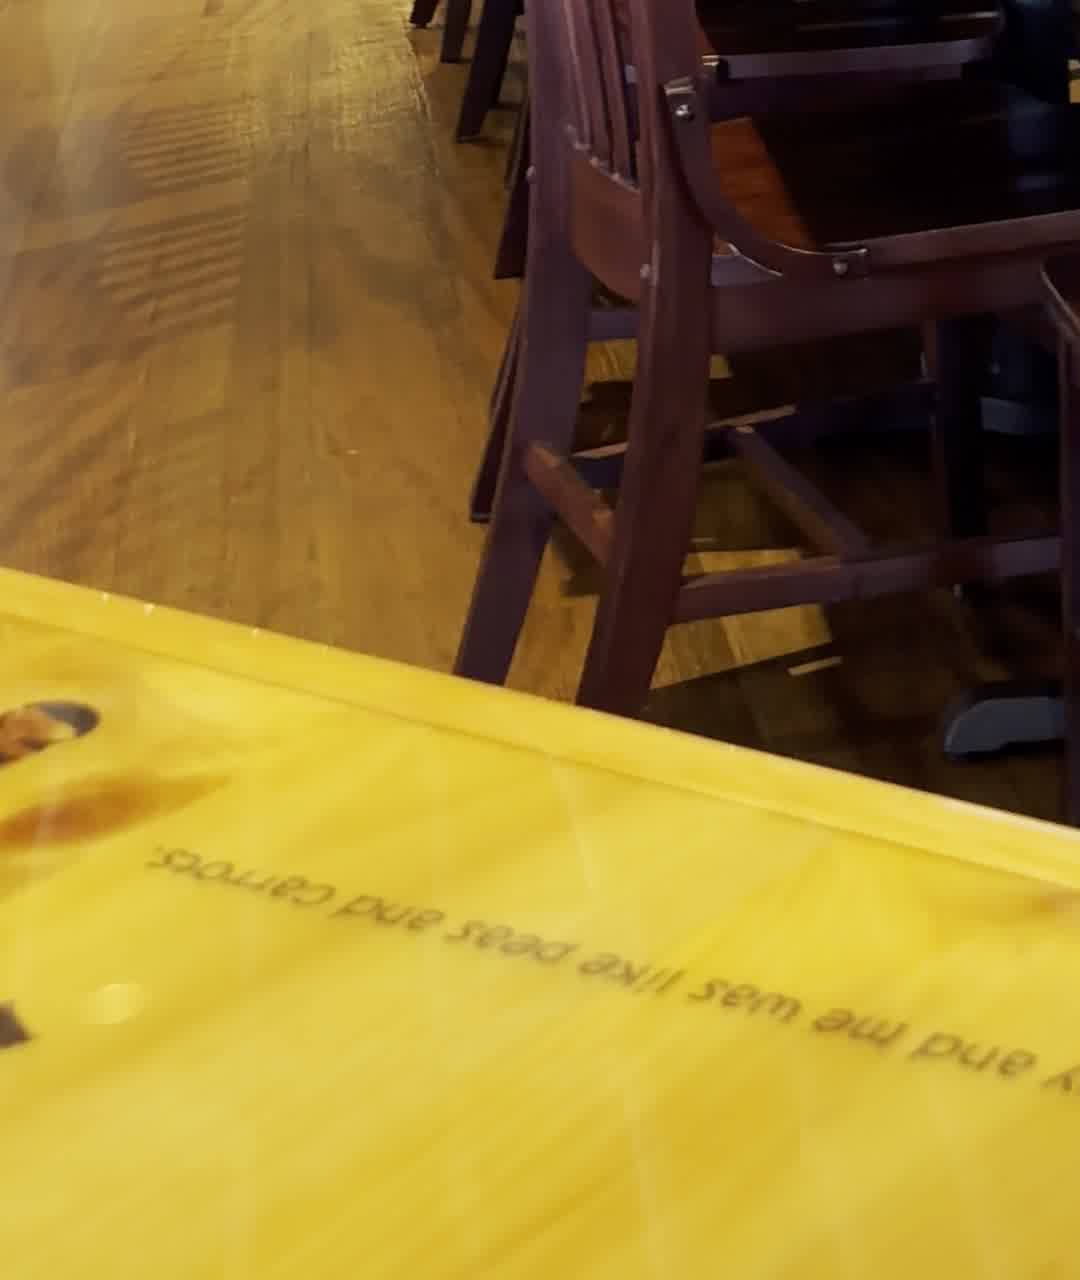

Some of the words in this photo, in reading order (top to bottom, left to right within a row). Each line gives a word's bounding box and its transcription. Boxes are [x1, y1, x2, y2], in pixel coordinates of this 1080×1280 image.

[144, 842, 338, 907] carrots.
[327, 893, 447, 933] and
[443, 919, 578, 967] peas
[578, 953, 686, 996] like
[687, 977, 804, 1025] was
[811, 1008, 909, 1053] me
[906, 1031, 1038, 1079] and
